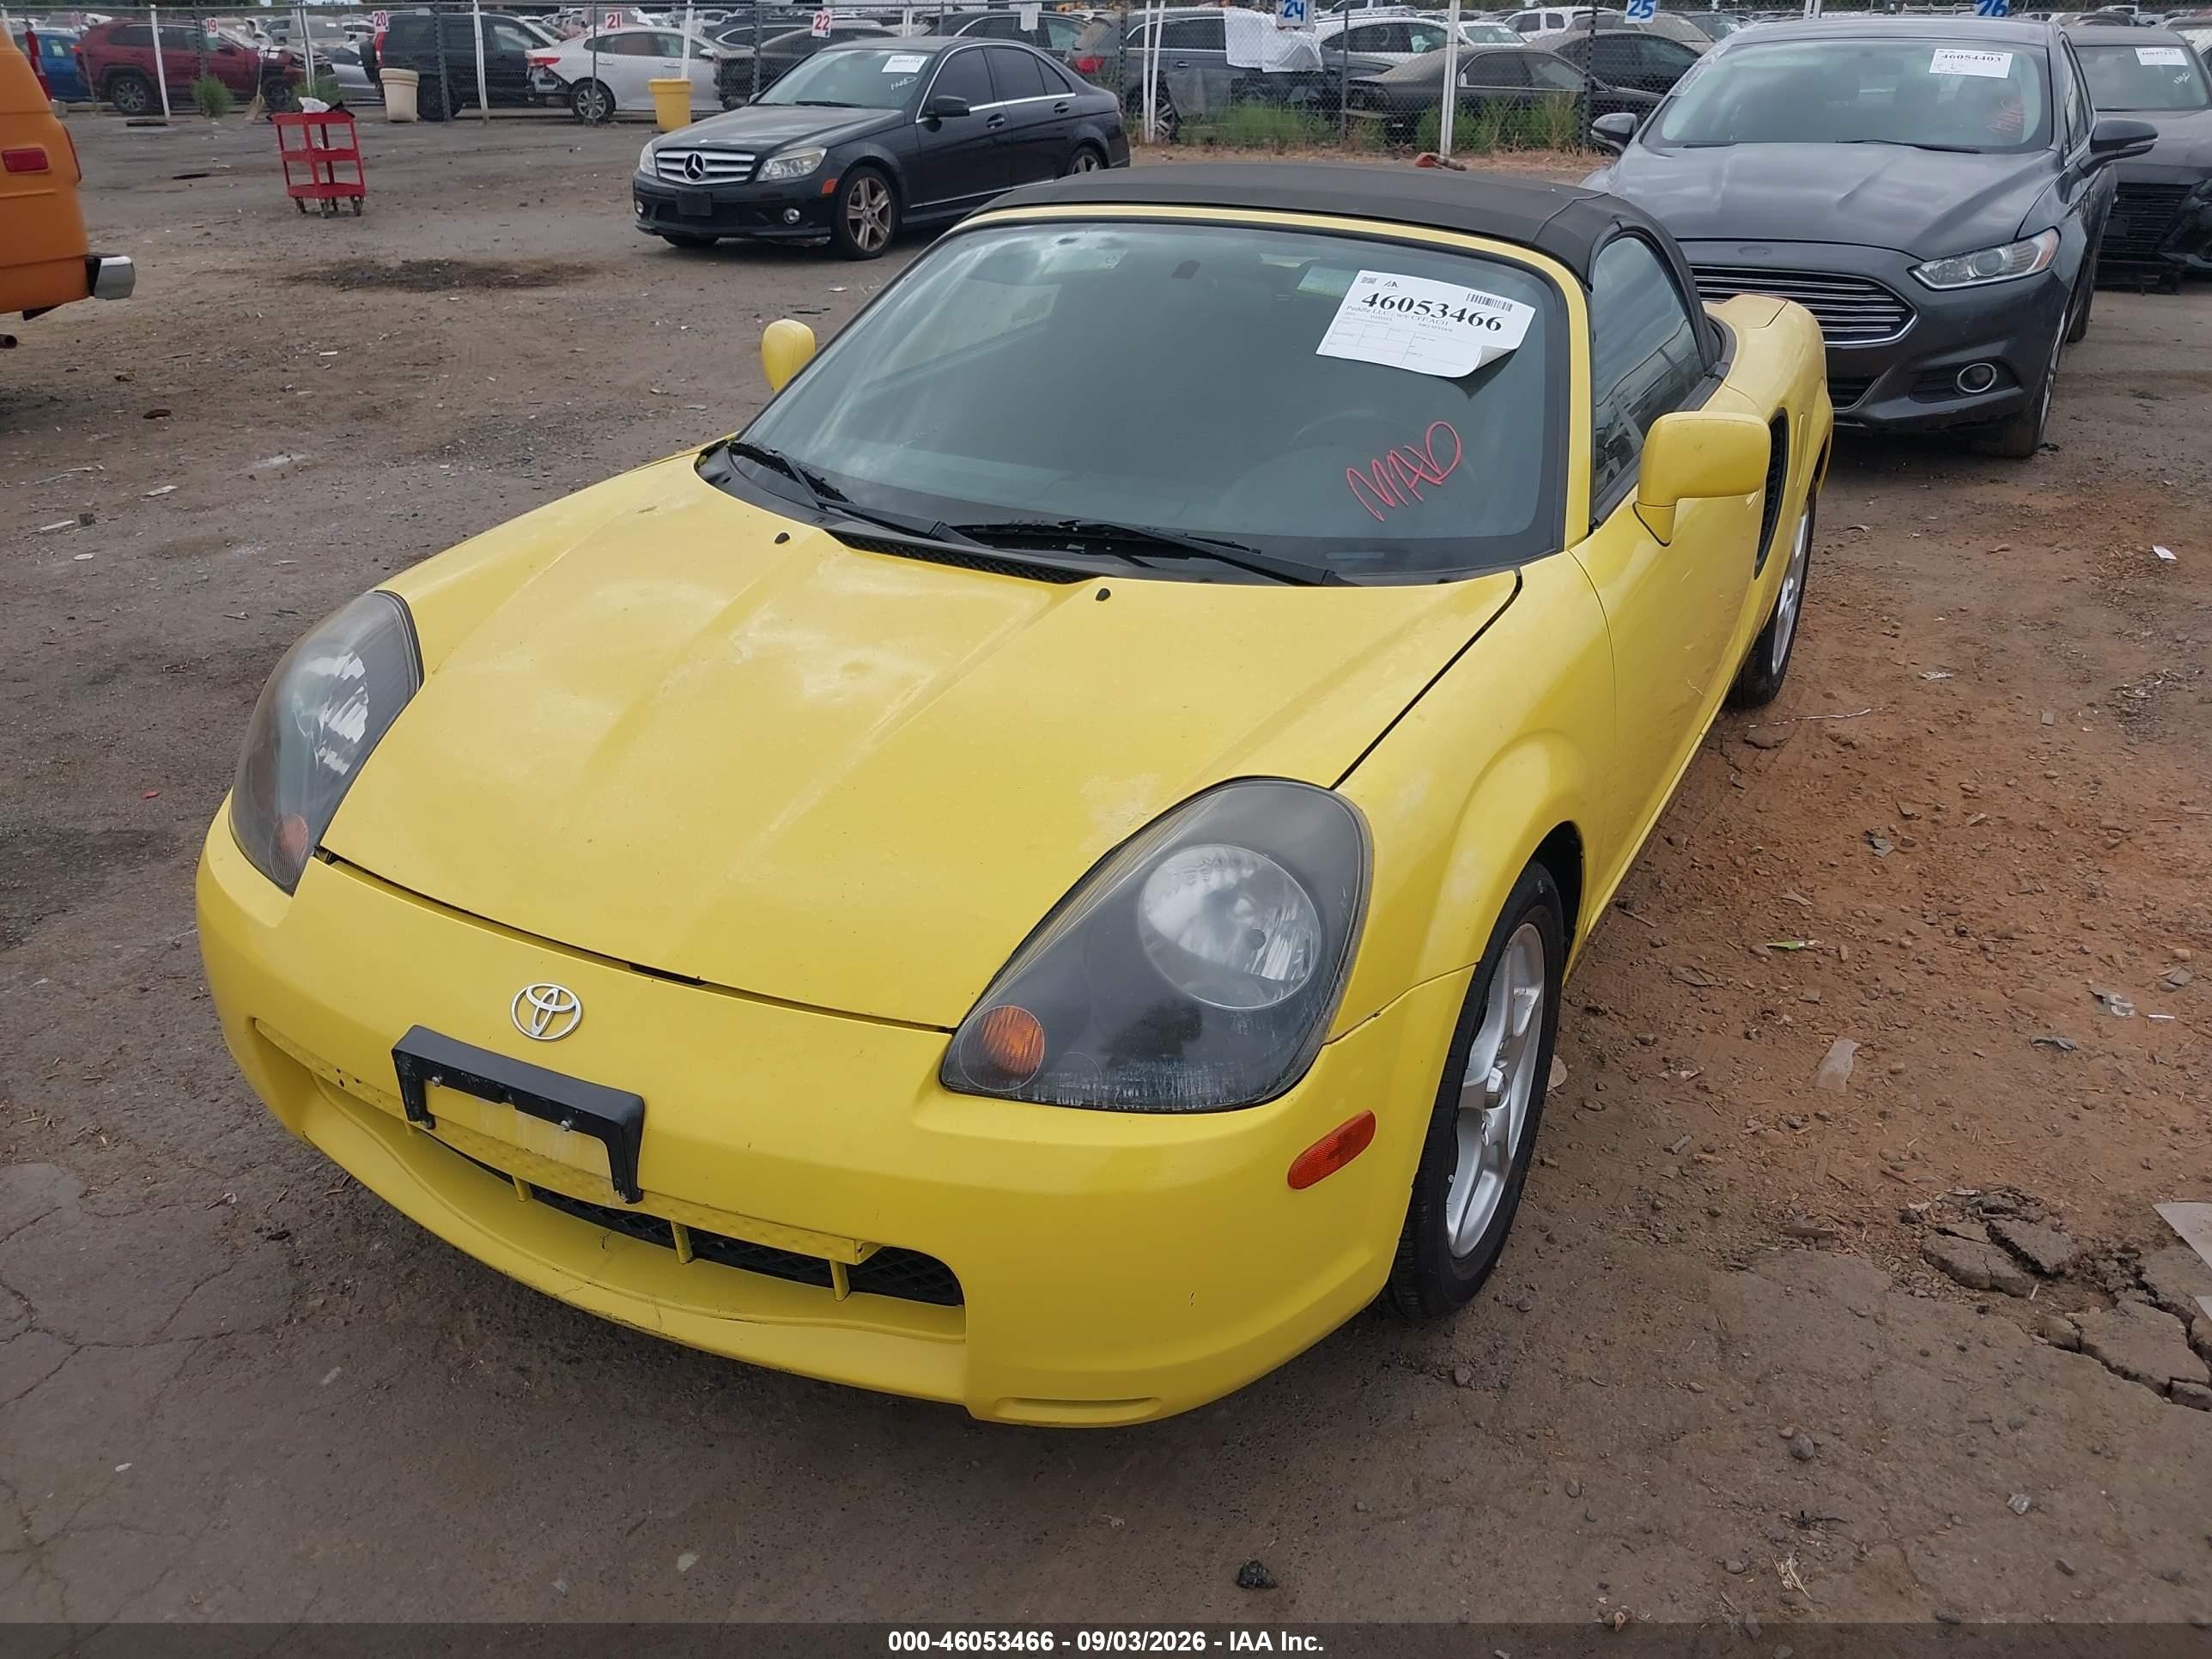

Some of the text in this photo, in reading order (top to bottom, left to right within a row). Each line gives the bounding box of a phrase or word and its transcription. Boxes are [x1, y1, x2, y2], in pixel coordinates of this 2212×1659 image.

[1284, 0, 1304, 21] 24
[1627, 0, 1654, 19] 25
[1977, 0, 2007, 17] 26
[207, 19, 217, 33] 19
[374, 12, 386, 27] 20
[607, 13, 620, 29] 21
[815, 14, 830, 31] 22
[1362, 293, 1503, 331] 46053466
